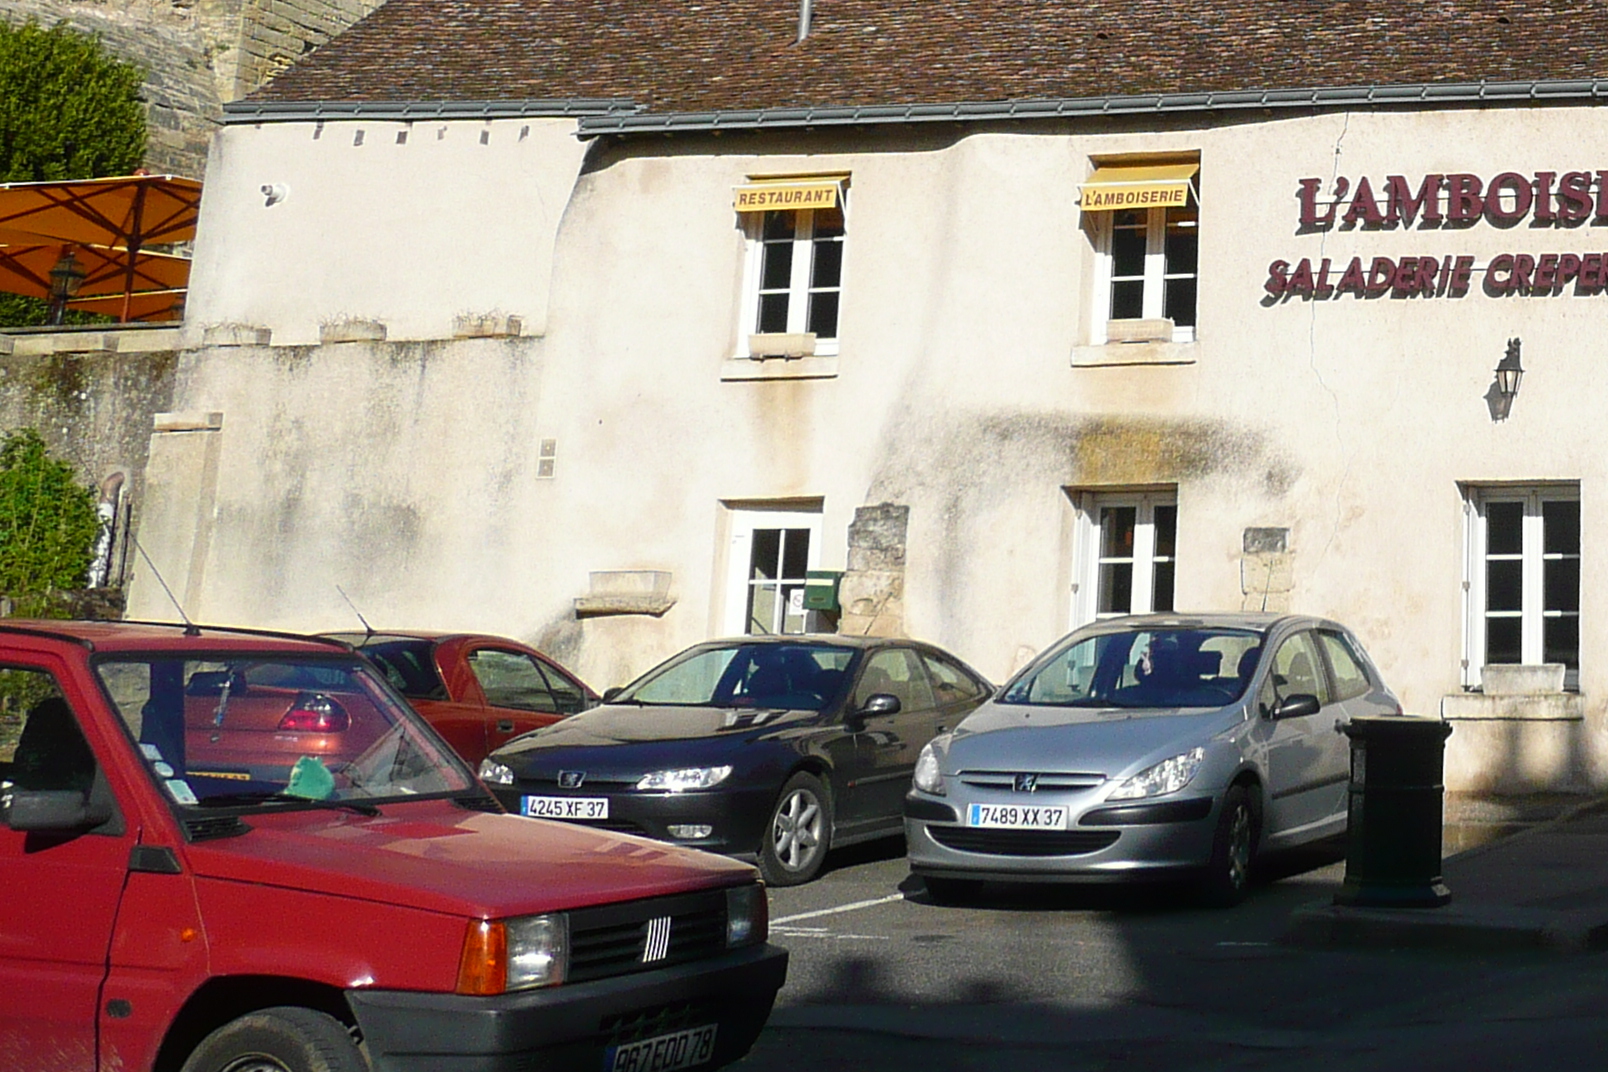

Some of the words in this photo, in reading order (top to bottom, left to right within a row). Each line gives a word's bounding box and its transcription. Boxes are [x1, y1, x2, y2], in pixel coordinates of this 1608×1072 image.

[738, 189, 835, 206] RESTAURANT
[1085, 189, 1185, 207] L'AMBOISERIE
[1260, 254, 1476, 307] SALADERIE
[530, 799, 562, 816] 4245
[566, 801, 583, 816] XF
[587, 801, 605, 817] 37
[981, 807, 1018, 824] 7489
[1021, 808, 1040, 825] XX
[1044, 809, 1062, 826] 37
[691, 1029, 712, 1063] 78
